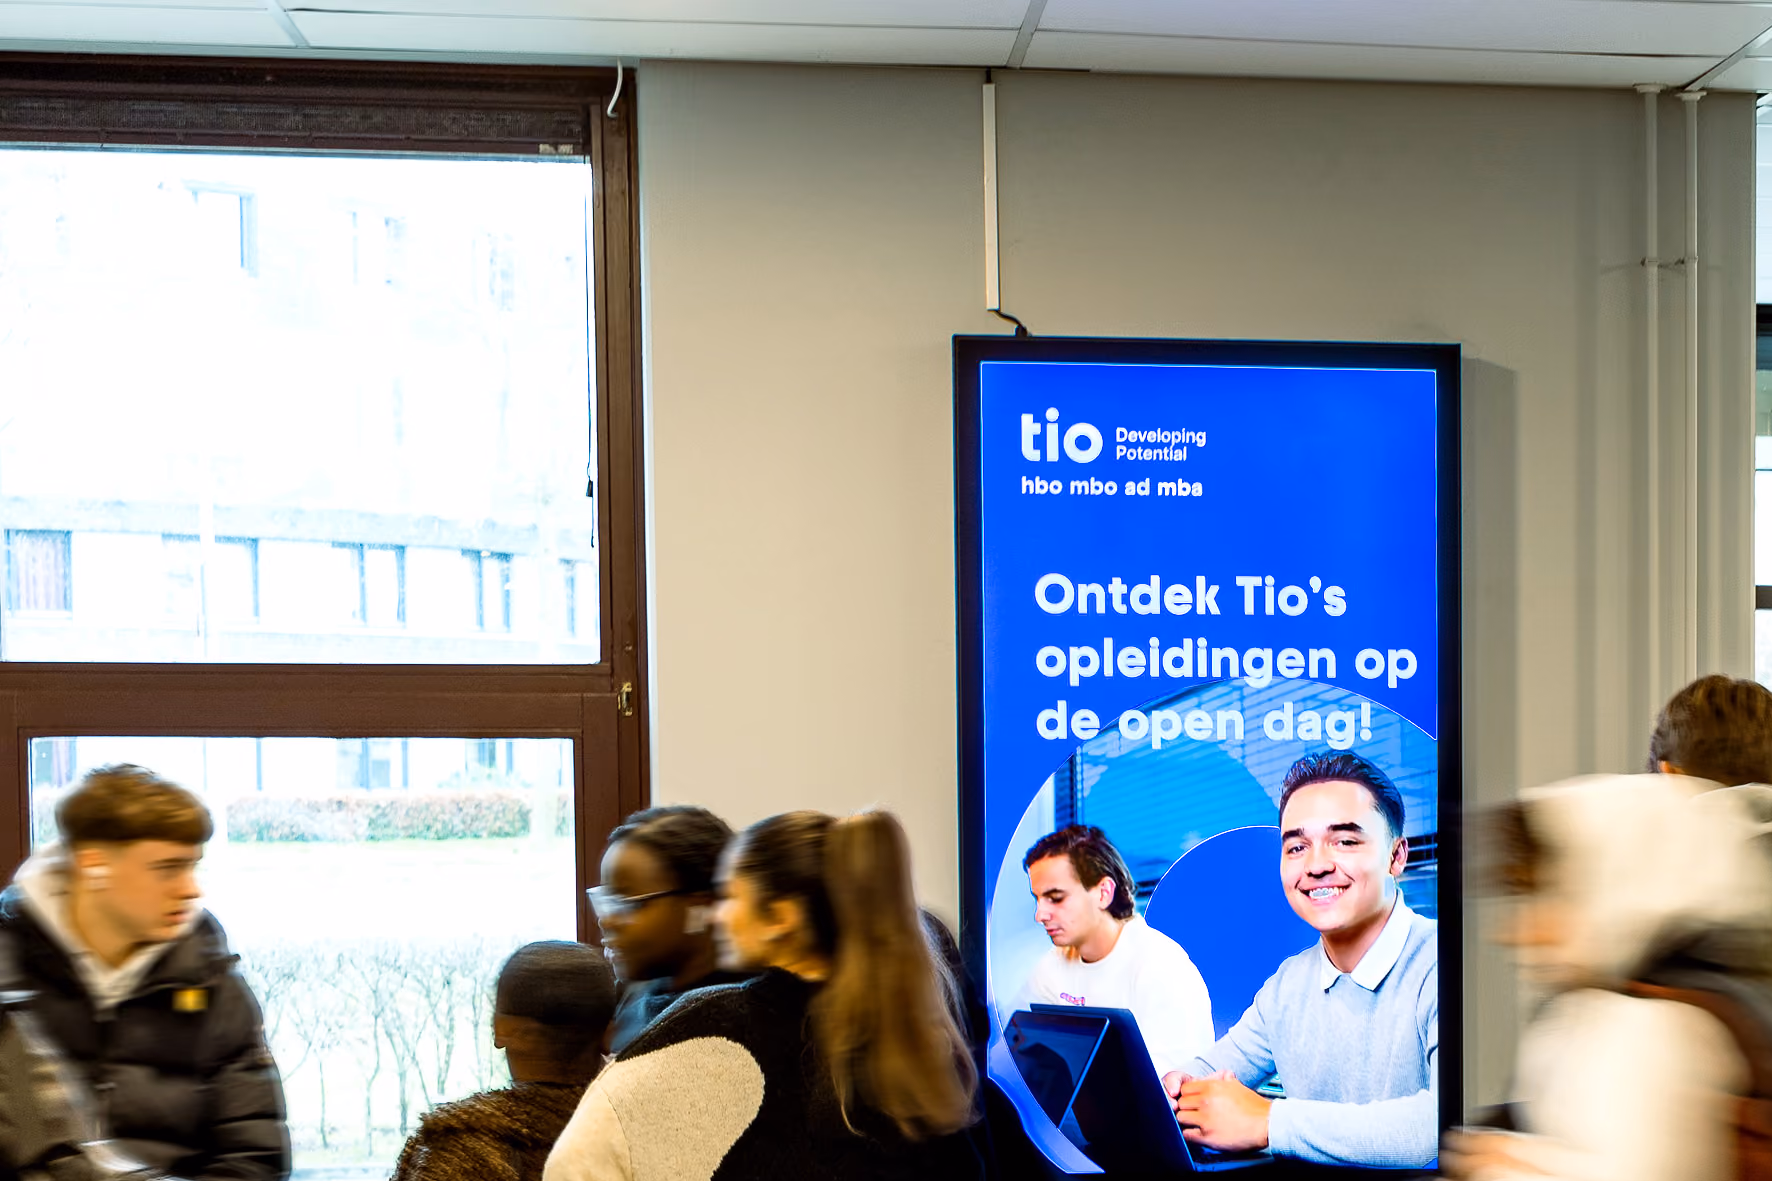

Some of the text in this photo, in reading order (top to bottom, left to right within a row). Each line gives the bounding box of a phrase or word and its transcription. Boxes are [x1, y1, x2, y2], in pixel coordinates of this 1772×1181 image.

[1021, 407, 1103, 463] tio
[1116, 427, 1206, 447] Developing
[1116, 445, 1187, 461] Potential
[1021, 476, 1203, 497] hbo mbo ad mba
[1034, 572, 1347, 617] Ontdek Tio's
[1035, 637, 1418, 688] opleidingen op
[1036, 700, 1373, 750] de open dag!
